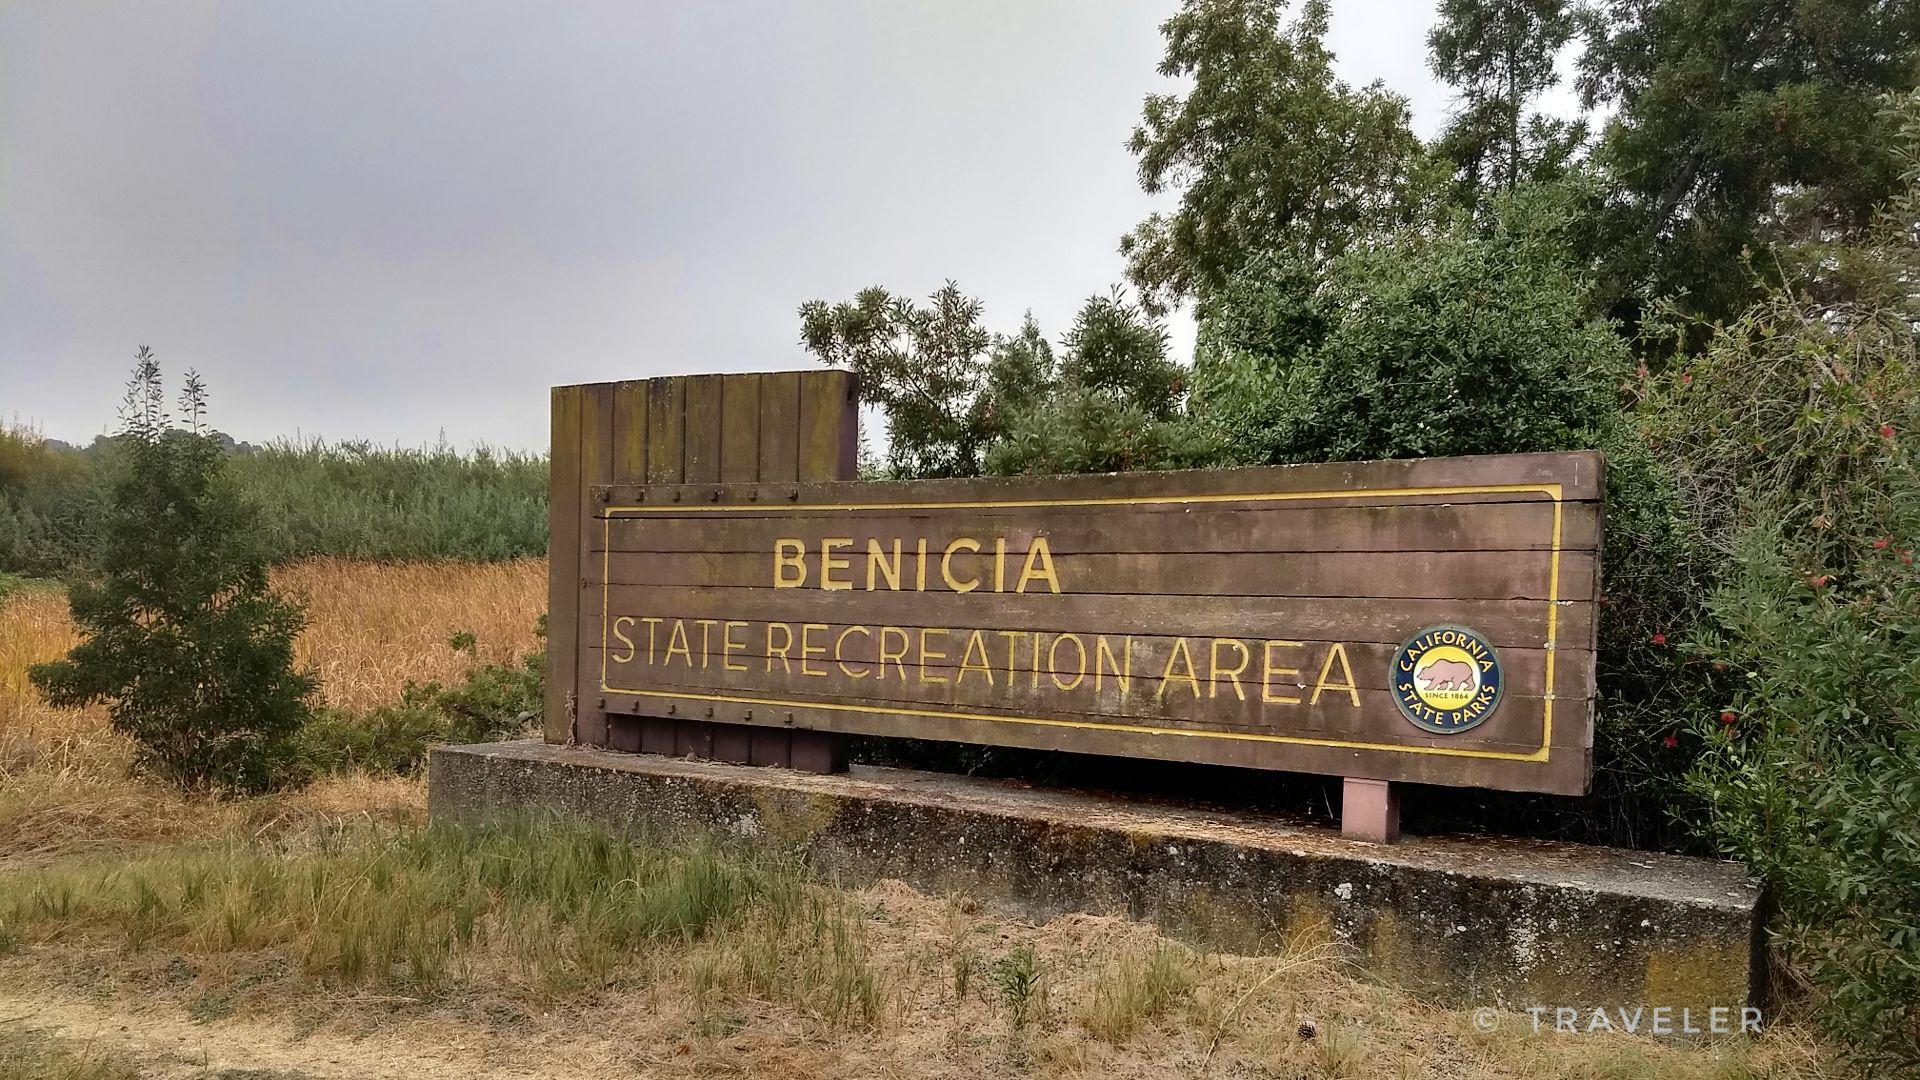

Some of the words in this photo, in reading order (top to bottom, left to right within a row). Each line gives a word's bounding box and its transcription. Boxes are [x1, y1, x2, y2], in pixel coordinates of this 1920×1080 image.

[773, 536, 1061, 594] BENICIA
[611, 616, 750, 671] STATE
[766, 621, 1132, 694] RECREATION
[1156, 636, 1362, 707] AREA
[1400, 631, 1494, 673] CALIFORNIA
[1399, 683, 1444, 725] STATE
[1452, 684, 1495, 725] PARKS
[1425, 692, 1449, 700] SINCE
[1450, 692, 1469, 700] 1864
